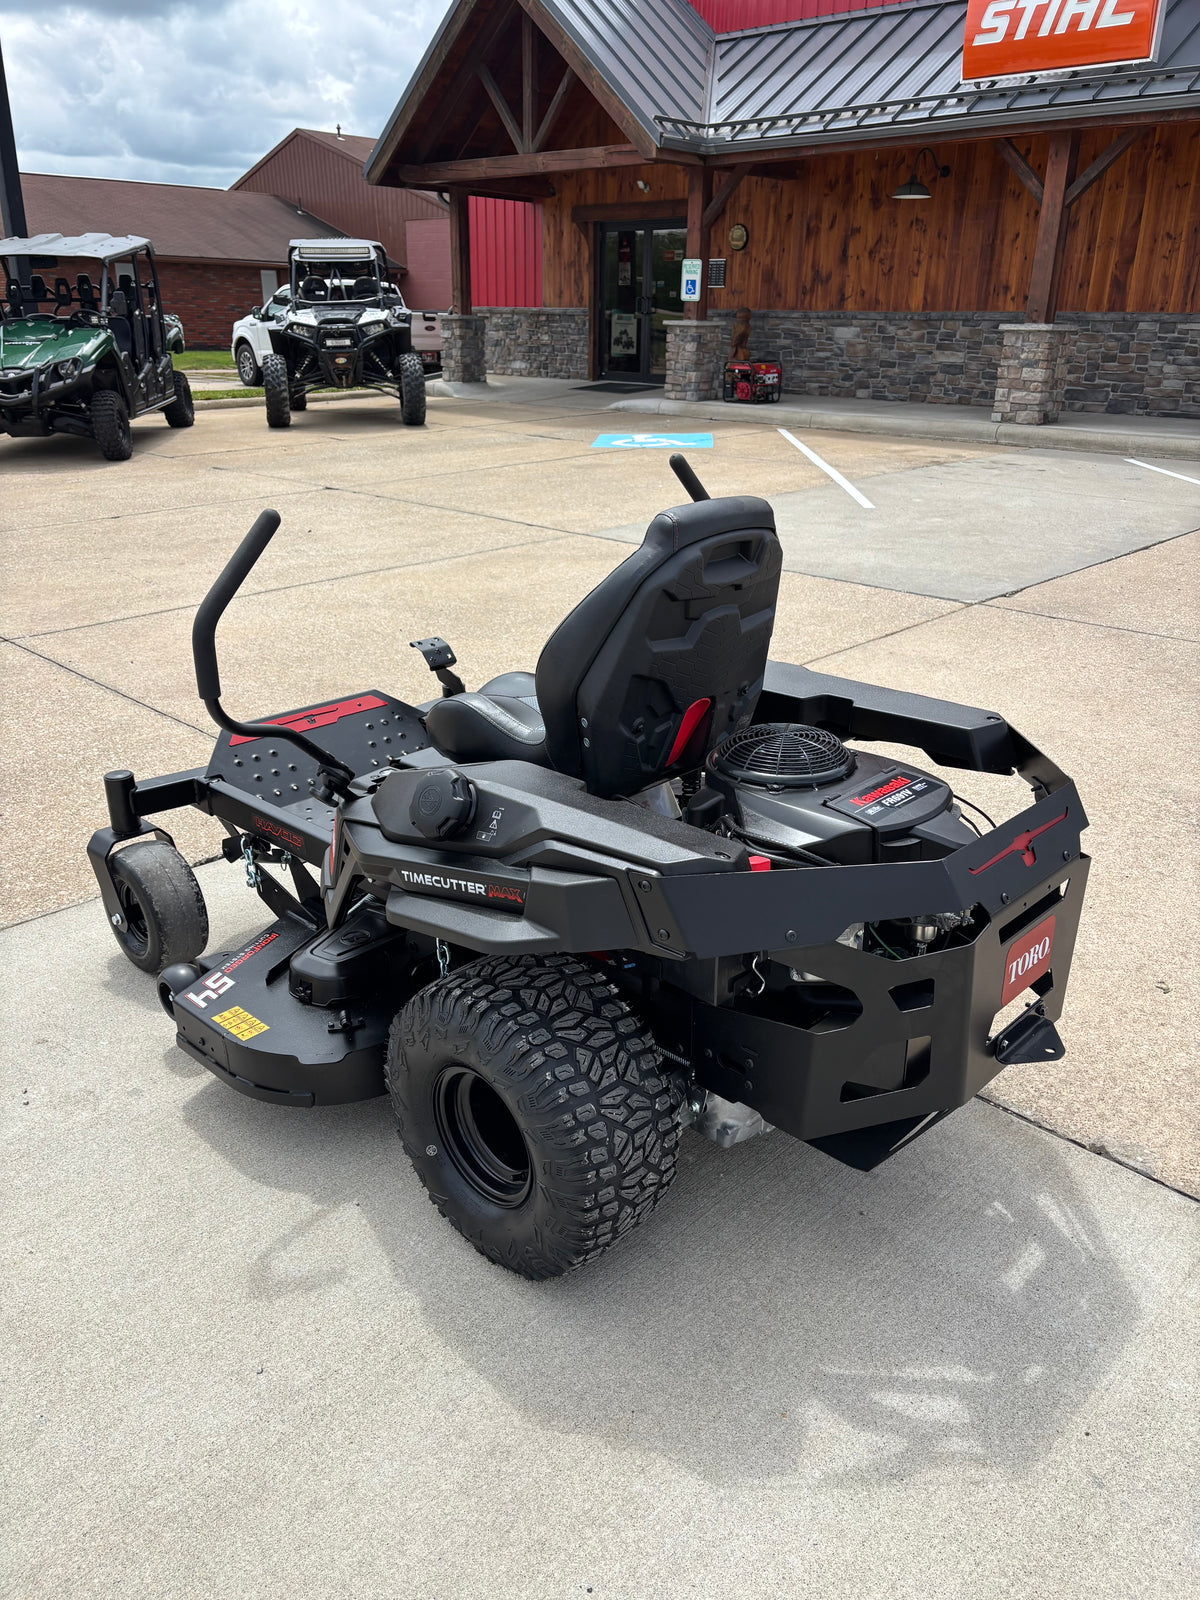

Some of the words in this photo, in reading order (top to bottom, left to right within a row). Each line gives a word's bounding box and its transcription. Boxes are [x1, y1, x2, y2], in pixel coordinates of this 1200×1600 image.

[972, 0, 1136, 46] STIHL
[849, 776, 912, 807] Kawasaki
[401, 870, 487, 896] TIMECUTTER
[488, 884, 523, 903] MAX
[224, 933, 279, 974] IRONFORGED
[1008, 936, 1050, 985] TORO
[184, 971, 236, 1009] 54
